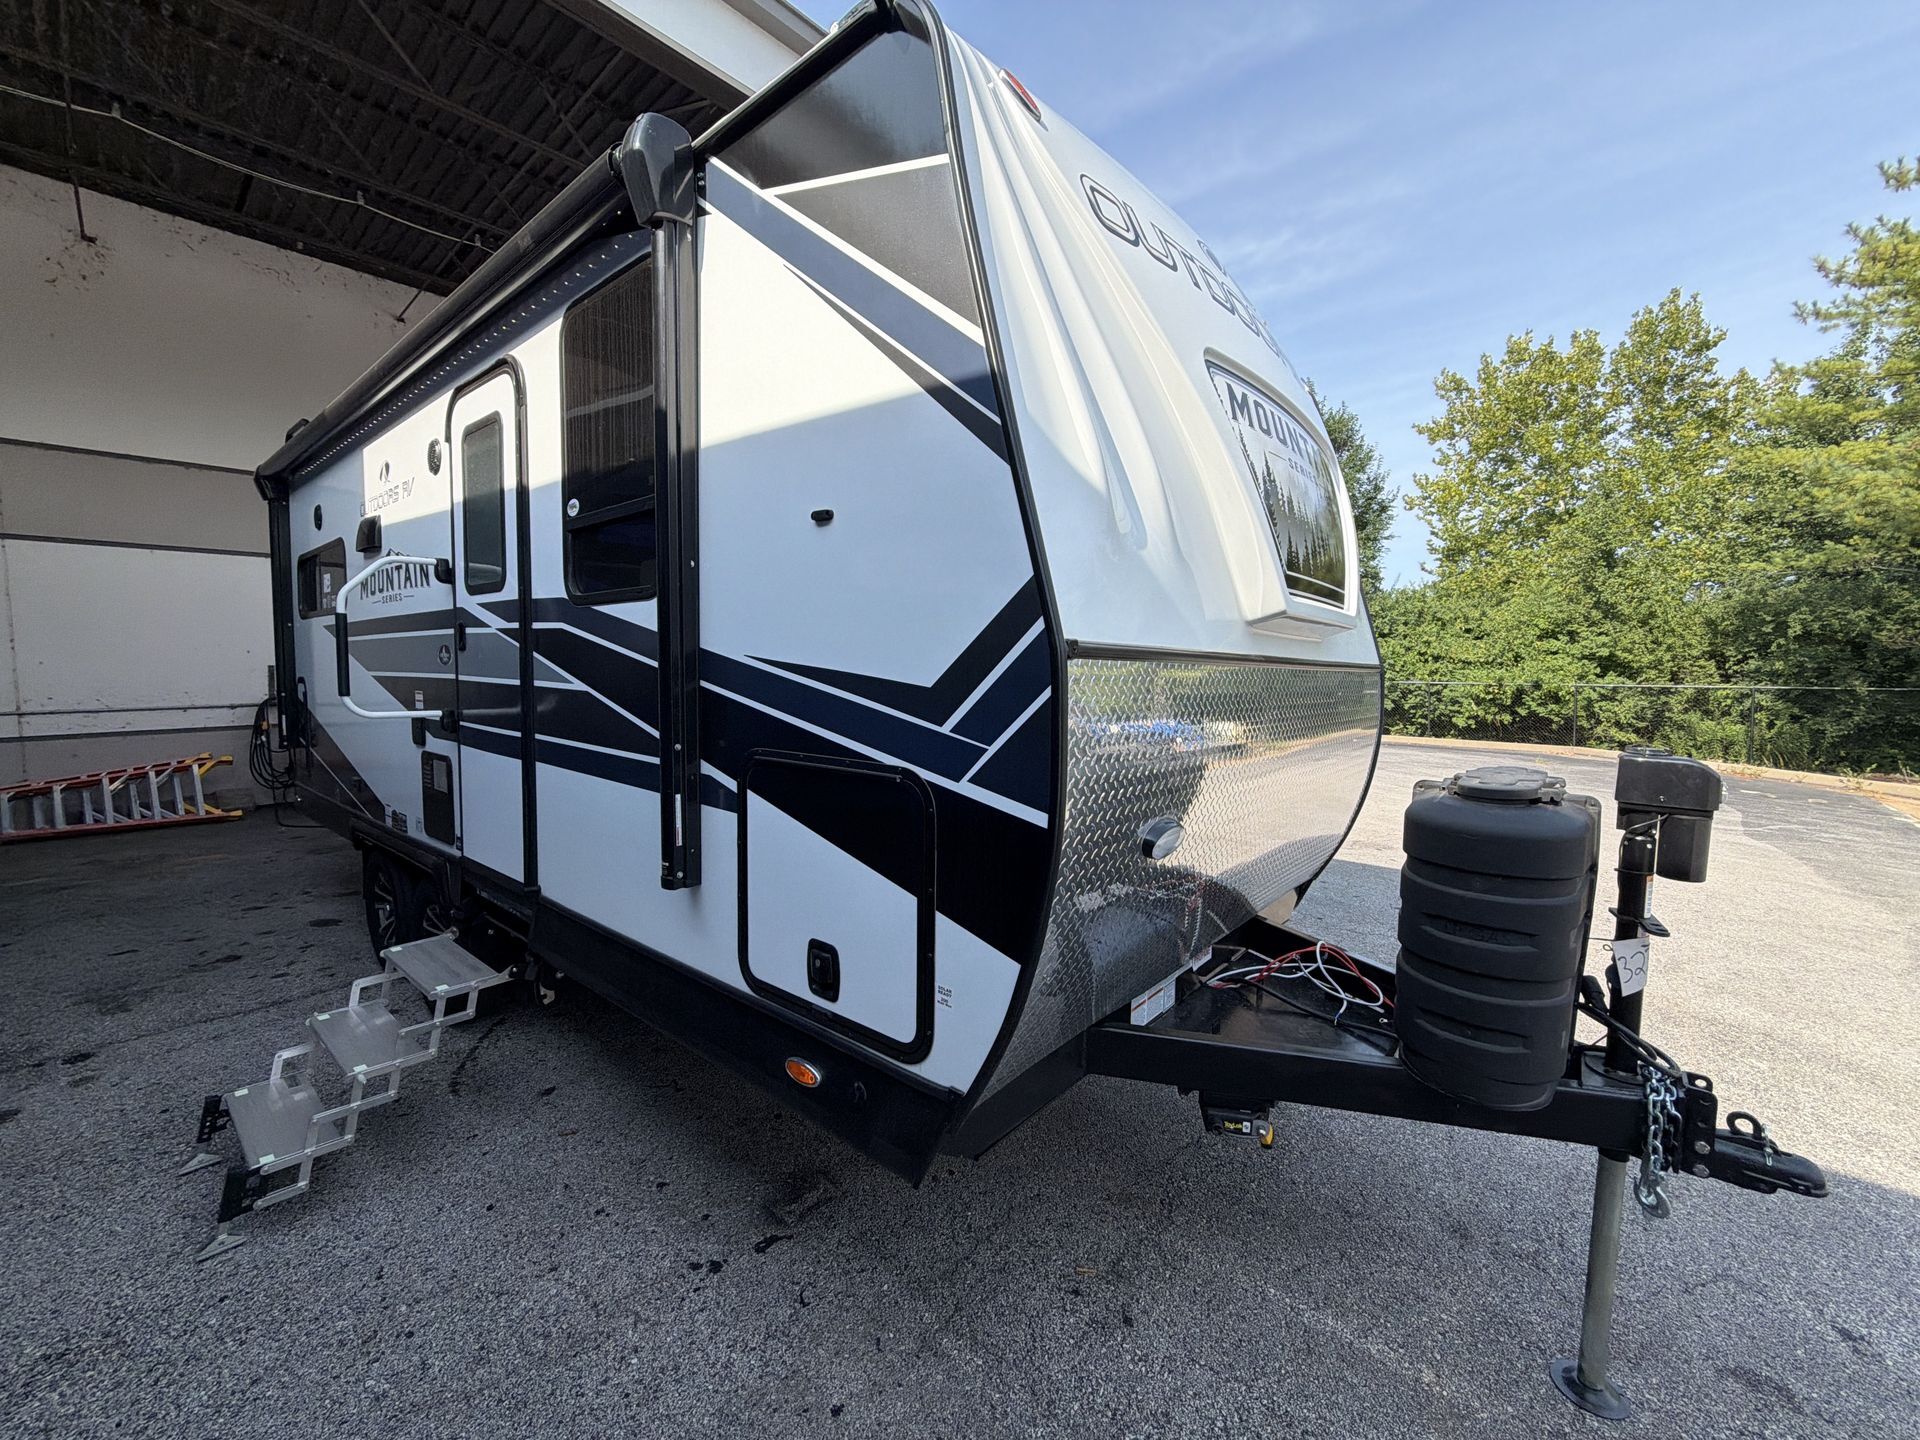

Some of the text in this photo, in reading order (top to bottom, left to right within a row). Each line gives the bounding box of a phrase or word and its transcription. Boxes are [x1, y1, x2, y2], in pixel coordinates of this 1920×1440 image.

[1080, 174, 1286, 366] OUTDOO
[359, 476, 415, 517] OUTDOORS RV
[360, 563, 431, 600] MOUNTAIN
[382, 593, 403, 604] SERIES
[1617, 944, 1650, 984] 32
